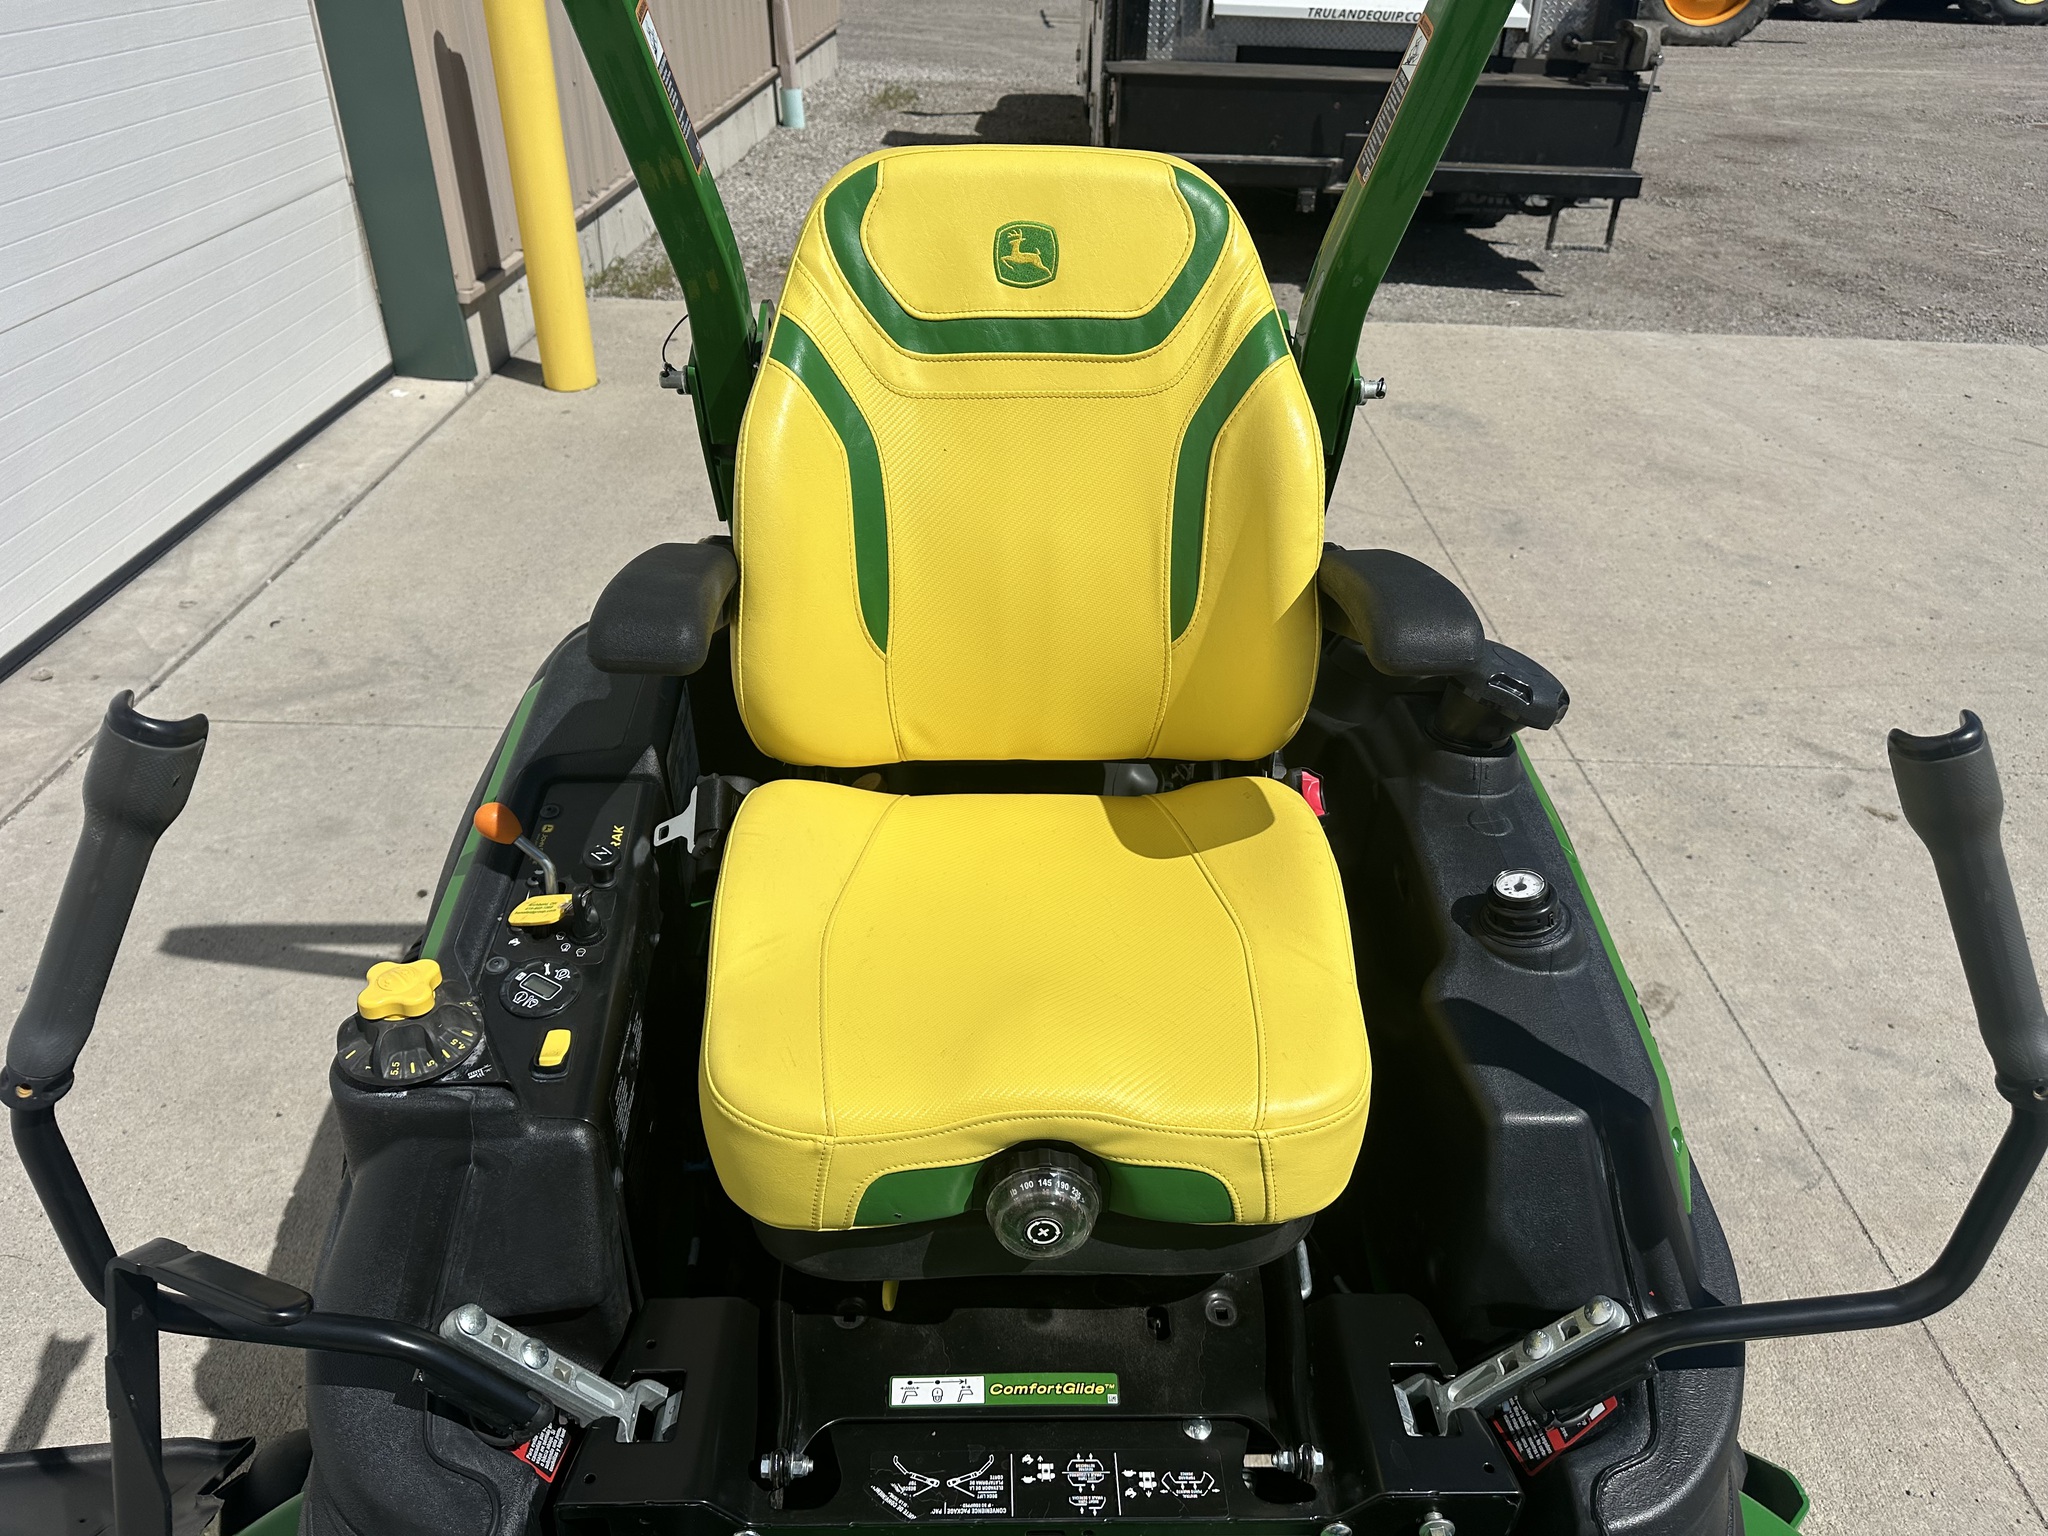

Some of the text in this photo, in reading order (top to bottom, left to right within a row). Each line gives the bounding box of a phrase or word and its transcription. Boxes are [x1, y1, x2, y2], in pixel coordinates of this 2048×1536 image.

[1307, 7, 1421, 22] TRULANDEQUIP.CO
[390, 1061, 400, 1076] 5.5
[1020, 1180, 1034, 1191] 100
[1038, 1178, 1052, 1187] 145
[1056, 1180, 1070, 1191] 190
[947, 1507, 971, 1515] PACKAGE
